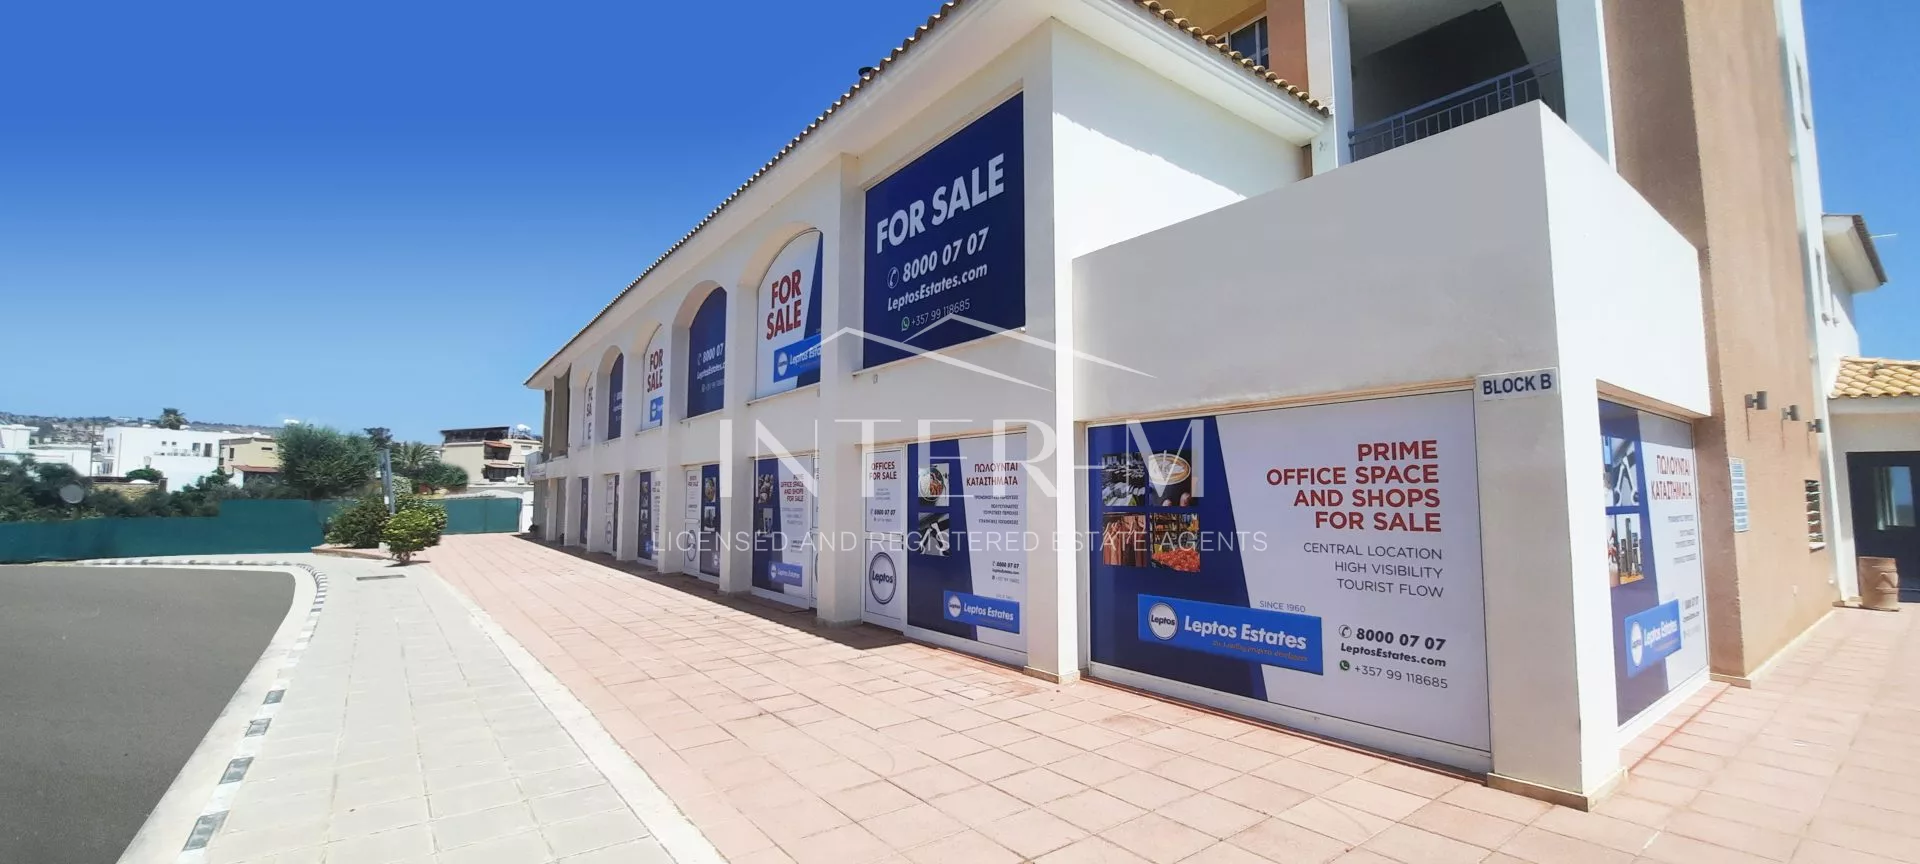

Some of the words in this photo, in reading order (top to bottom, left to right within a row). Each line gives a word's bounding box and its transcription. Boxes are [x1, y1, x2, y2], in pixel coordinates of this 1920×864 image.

[877, 200, 926, 254] FOR
[931, 153, 1004, 226] SALE
[902, 250, 938, 283] 8000
[942, 239, 963, 266] 07
[966, 226, 990, 256] 07
[771, 269, 801, 309] FOR
[887, 264, 988, 312] LeptosEstates.com
[766, 299, 802, 340] SALE
[930, 308, 941, 320] 99
[650, 348, 664, 372] FOR
[647, 368, 663, 393] SALE
[1483, 376, 1536, 395] BLOCK
[1540, 373, 1552, 390] B
[1357, 440, 1438, 462] PRIME
[871, 461, 895, 471] OFFICES
[882, 471, 897, 480] SALE
[974, 462, 1018, 473] ΠΩΛΟΥΝΤΑΙ
[1266, 467, 1347, 486] OFFICE
[1355, 464, 1439, 485] SPACE
[966, 476, 1018, 487] ΚΑΤΑΣΤΗΜΑΤΑ
[1294, 489, 1344, 507] AND
[1352, 488, 1440, 508] SHOPS
[1315, 511, 1364, 530] FOR
[1373, 512, 1442, 532] SALE
[1303, 542, 1364, 556] CENTRAL
[1367, 545, 1442, 560] LOCATION
[871, 570, 894, 585] Leptos
[1335, 561, 1367, 573] HIGH
[1371, 563, 1443, 579] VISIBILITY
[1337, 578, 1394, 593] TOURIST
[1399, 584, 1444, 598] FLOW
[963, 602, 986, 616] Leptos
[987, 606, 1014, 621] Estates
[1259, 600, 1285, 611] SINCE
[1286, 603, 1306, 613] 1960
[1150, 614, 1176, 626] Leptos
[1184, 615, 1237, 638] Leptos
[1240, 624, 1307, 650] Estates
[1356, 628, 1394, 644] 8000
[1399, 634, 1420, 647] 07
[1424, 637, 1446, 651] 07
[1341, 642, 1446, 667] LeptosEstates.com
[1354, 665, 1382, 677] +357
[1386, 669, 1402, 681] 99
[1406, 672, 1448, 689] 118685
